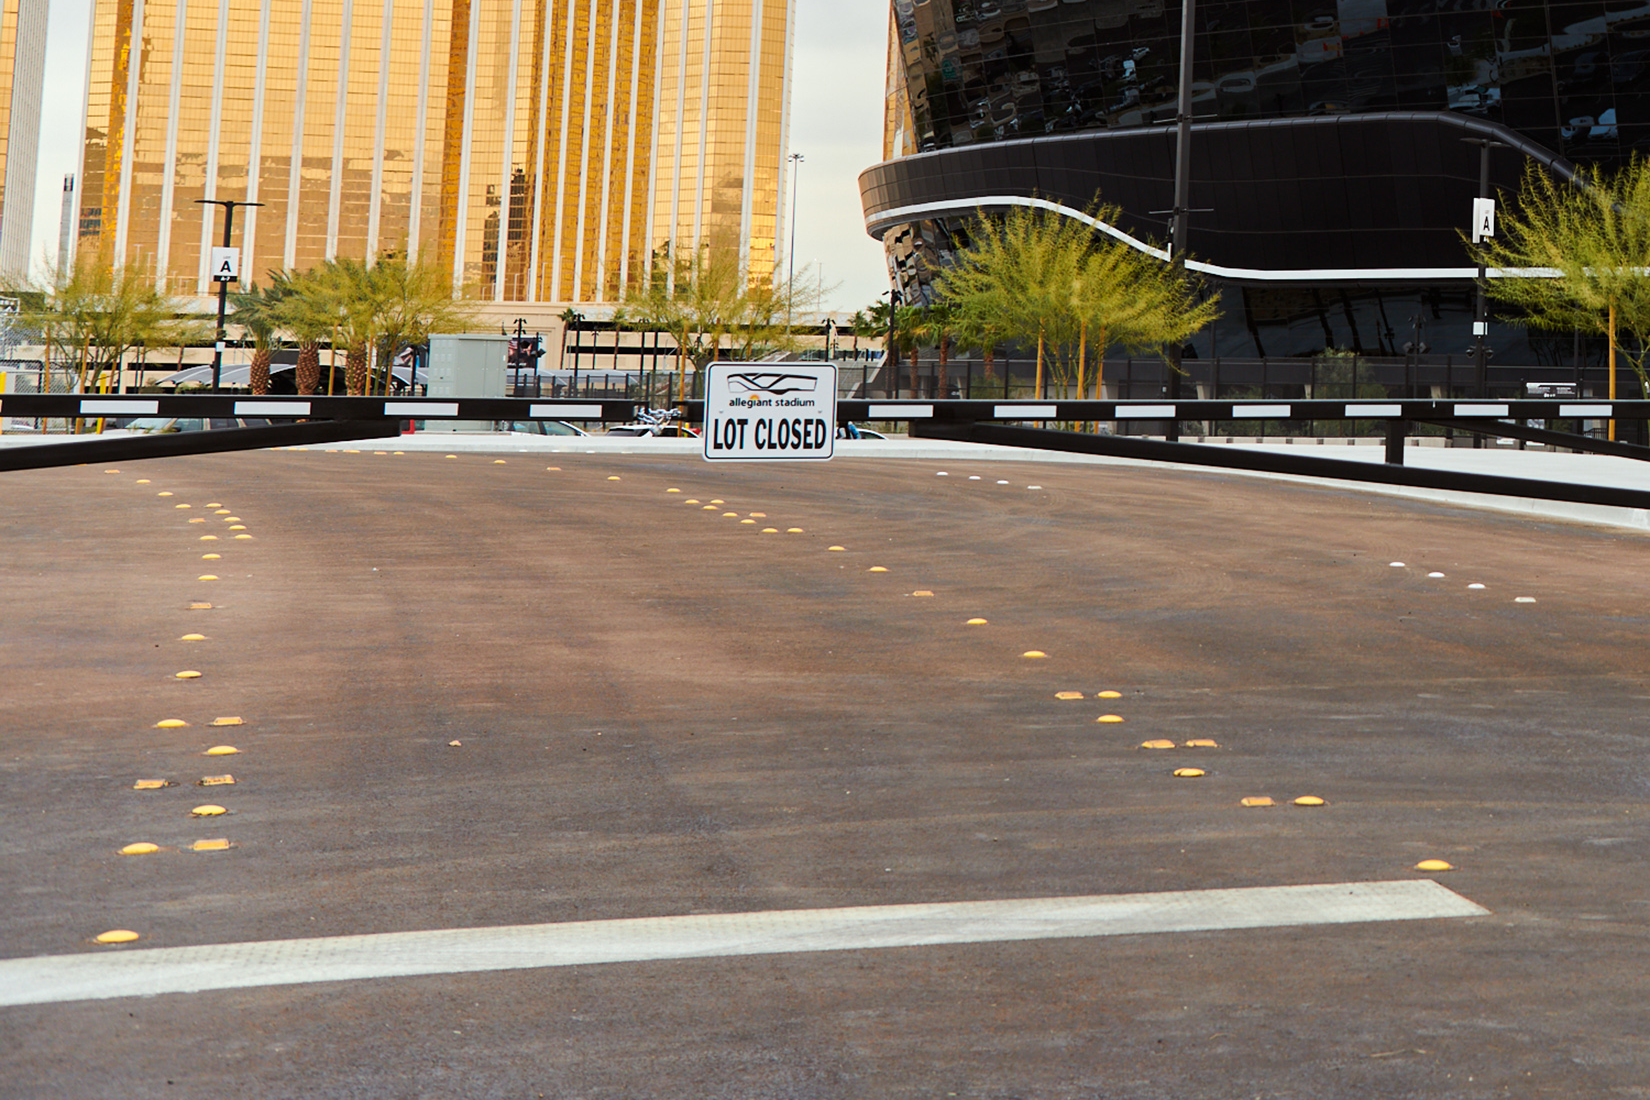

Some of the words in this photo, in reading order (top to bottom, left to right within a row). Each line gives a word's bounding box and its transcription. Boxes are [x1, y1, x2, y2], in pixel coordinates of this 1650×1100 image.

[1483, 216, 1490, 231] A
[220, 260, 231, 272] A
[729, 398, 772, 409] allegiant
[775, 398, 815, 407] stadium
[713, 418, 748, 450] LOT
[754, 418, 827, 450] CLOSED
